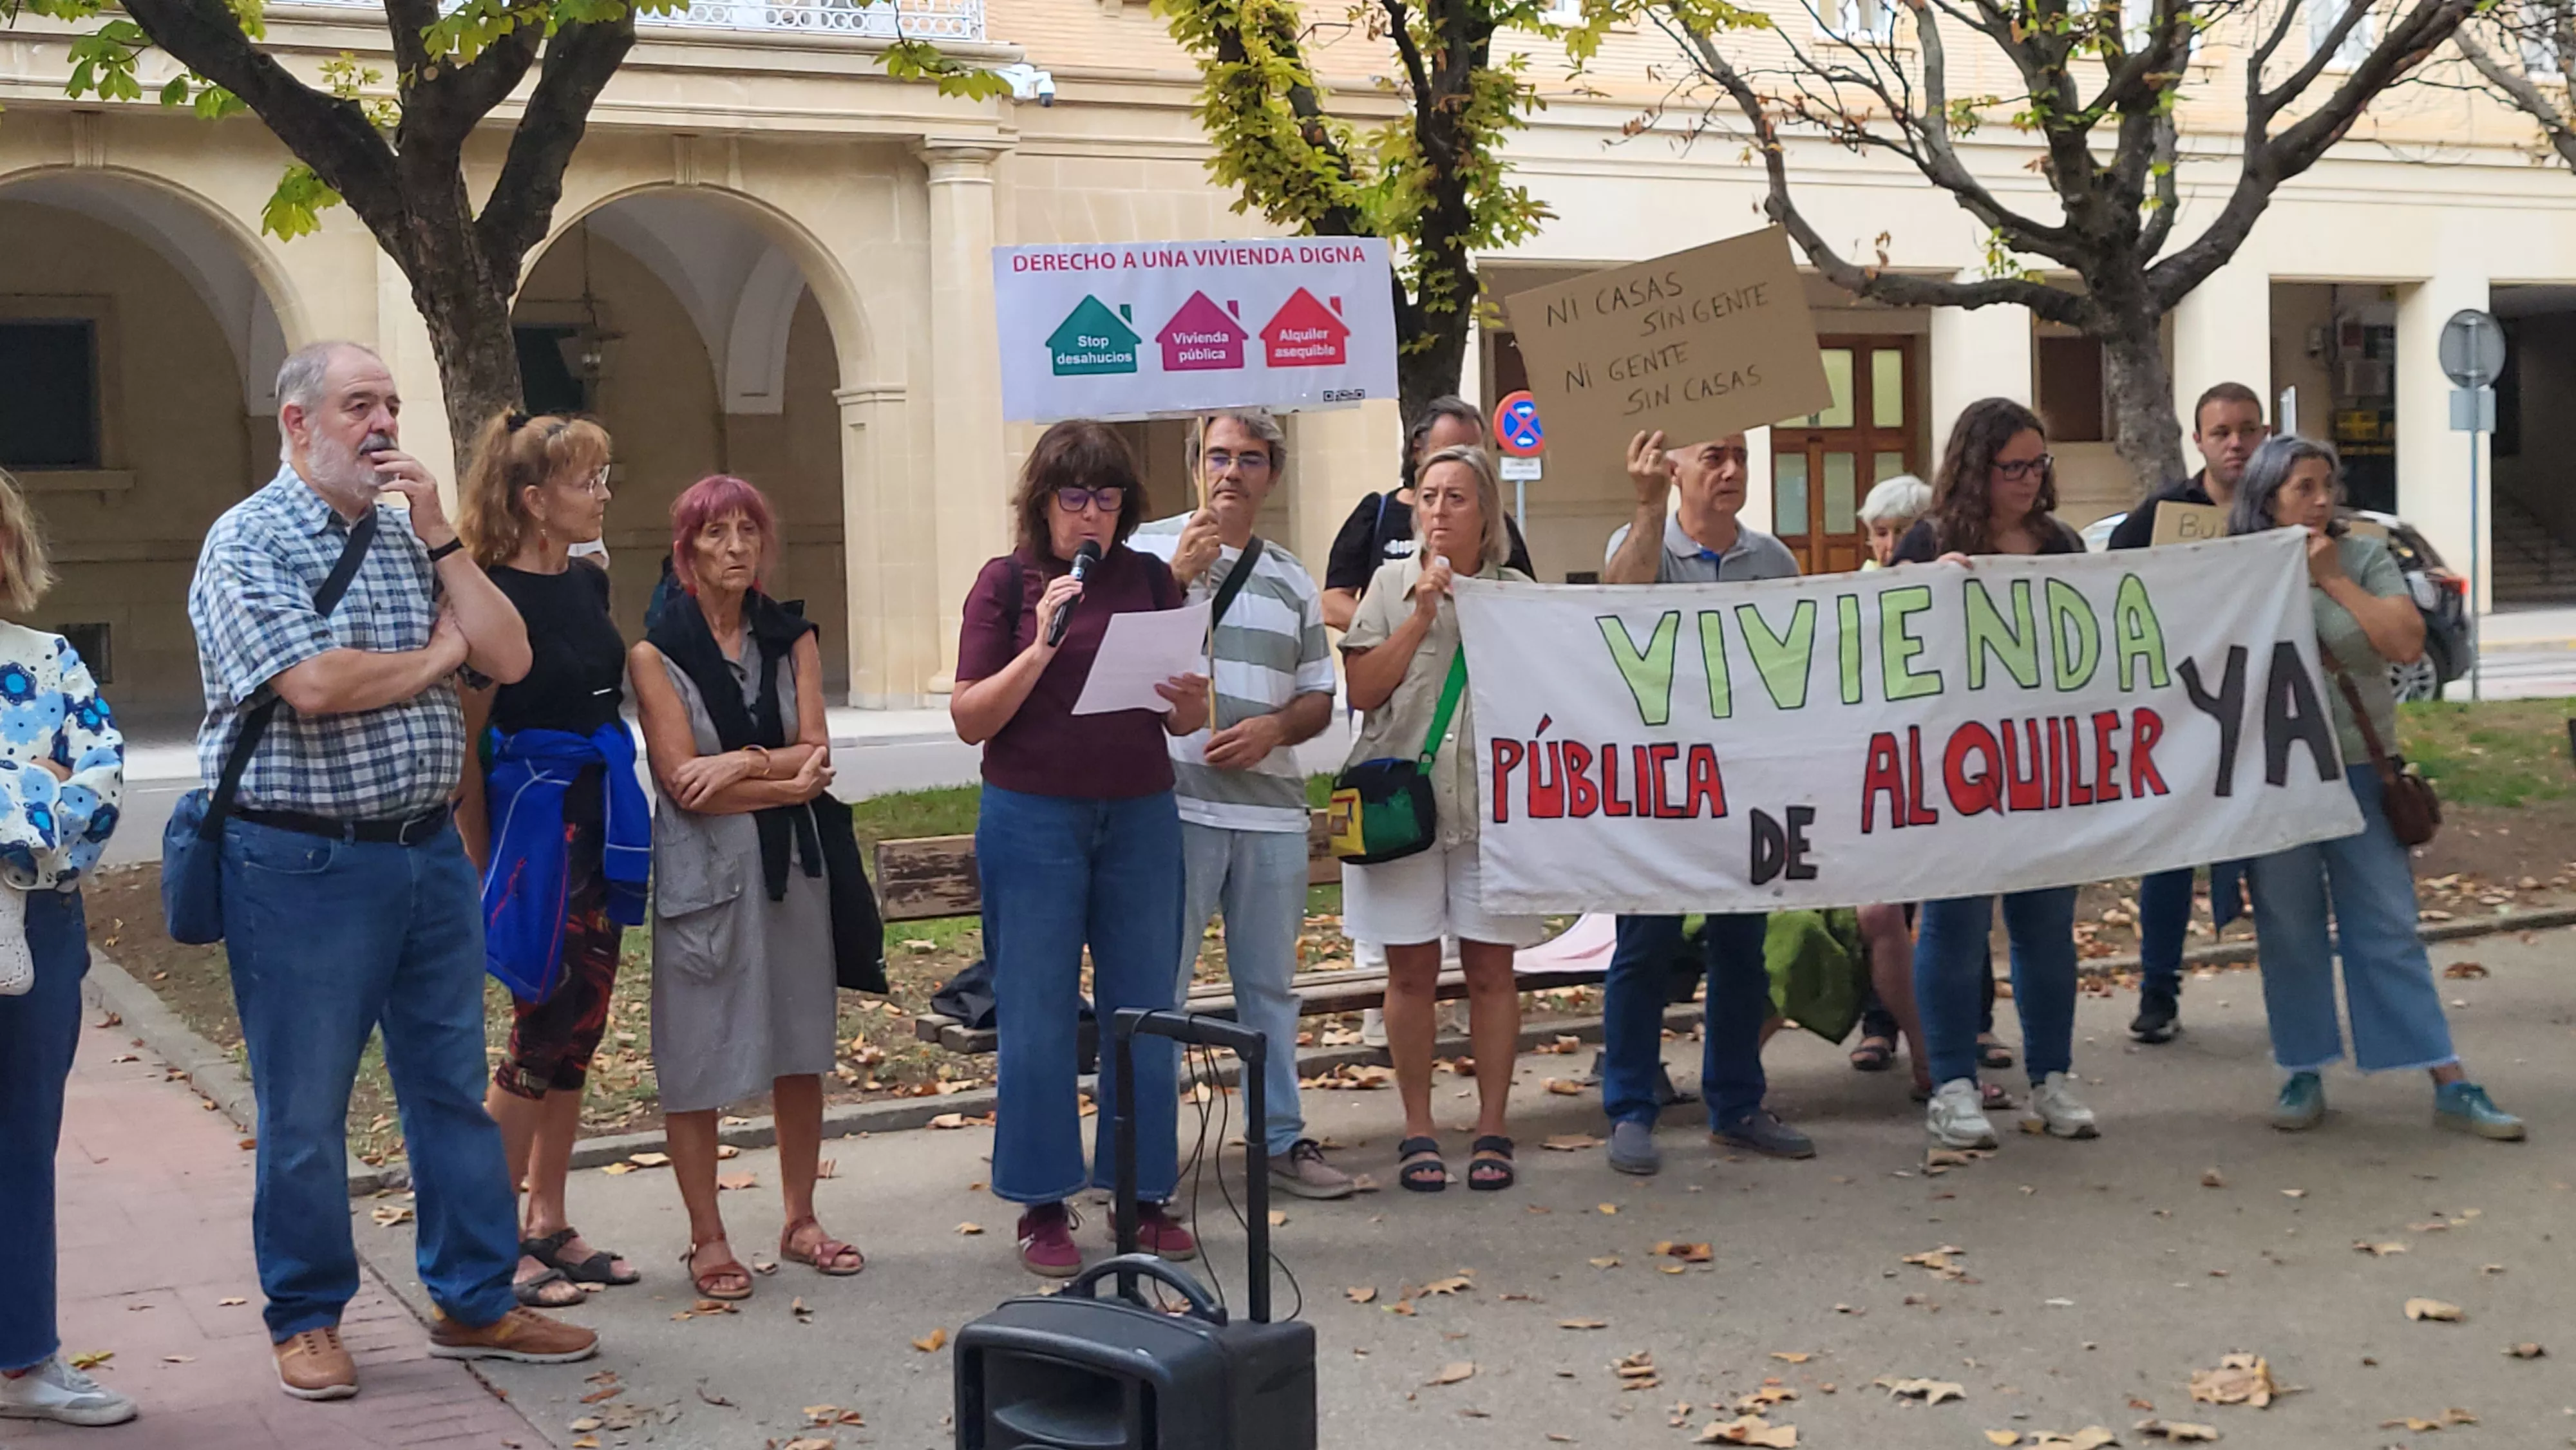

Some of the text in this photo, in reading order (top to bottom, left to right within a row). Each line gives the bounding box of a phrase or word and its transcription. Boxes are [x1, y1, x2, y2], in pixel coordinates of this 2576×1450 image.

[1014, 246, 1365, 272] DERECHO A UNA VIVIENDA DIGNA
[1595, 272, 1682, 315] CASAS
[1640, 281, 1768, 337] SIN GENTE
[1077, 335, 1109, 349] Stop
[1172, 331, 1229, 344] Vivienda
[1275, 343, 1336, 359] asequible
[1279, 327, 1329, 343] Alquiler
[1057, 351, 1133, 364] desahucios
[1179, 348, 1226, 363] pública
[1609, 341, 1688, 381] GENTE
[1624, 364, 1761, 415] SIN CASAS
[1595, 573, 2170, 726] VIVIENDA
[2175, 641, 2342, 797] YA
[1492, 708, 2170, 885] PÚBLICA DE ALQUILER
